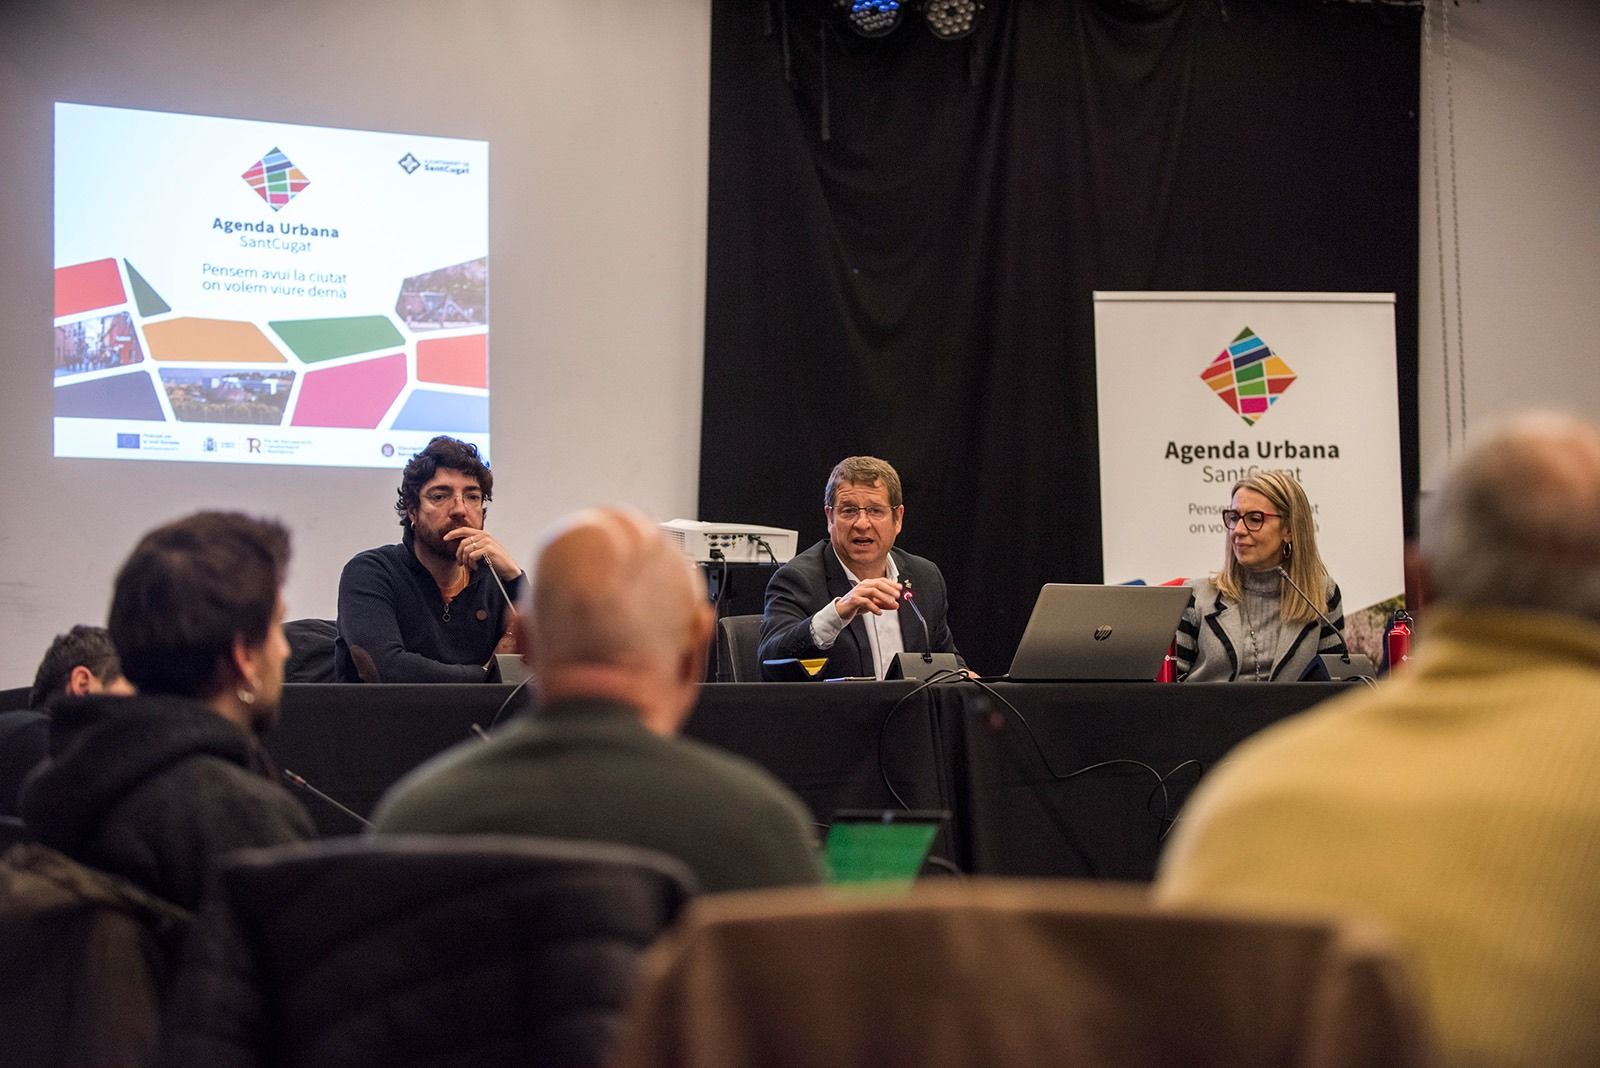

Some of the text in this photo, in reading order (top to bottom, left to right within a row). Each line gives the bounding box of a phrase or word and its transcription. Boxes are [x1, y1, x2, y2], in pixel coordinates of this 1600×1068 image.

[212, 218, 339, 238] Agenda Urbana
[240, 235, 312, 254] SantCugat
[202, 263, 347, 284] Pensem avui la ciutat
[202, 281, 347, 299] on volem viure demà
[1165, 440, 1340, 464] Agenda Urbana
[1188, 503, 1232, 515] Pense
[1189, 522, 1205, 534] on
